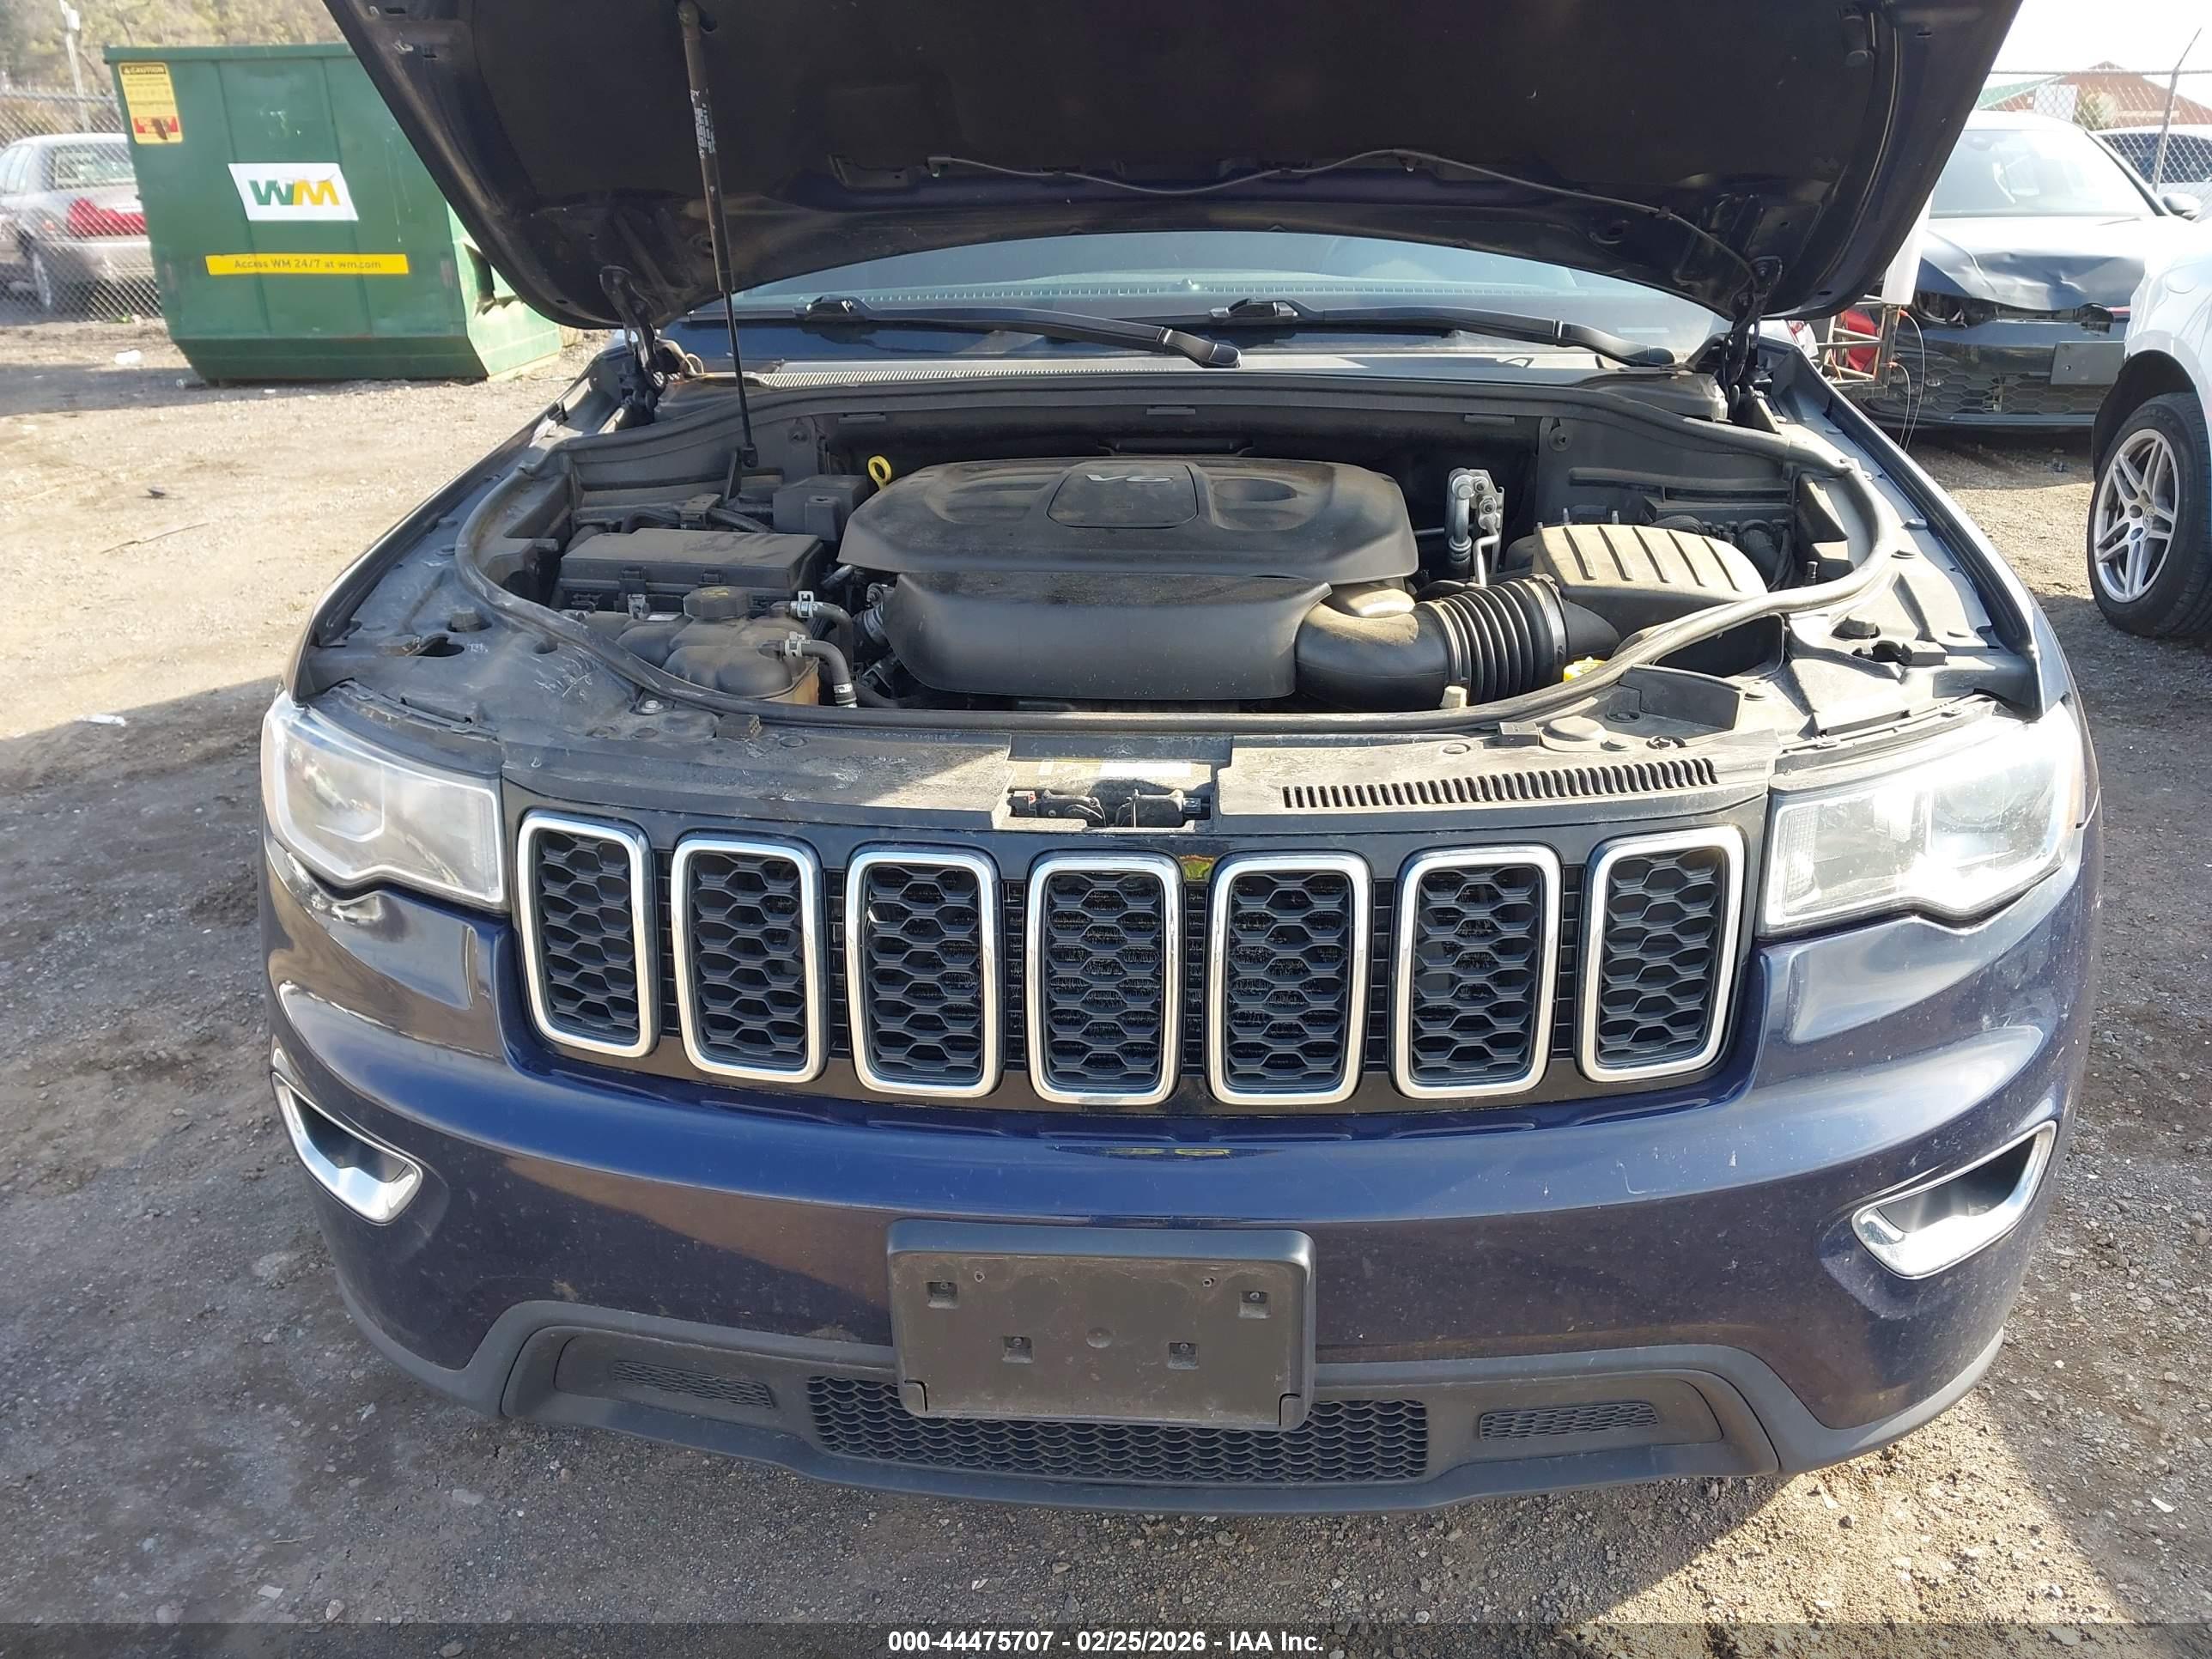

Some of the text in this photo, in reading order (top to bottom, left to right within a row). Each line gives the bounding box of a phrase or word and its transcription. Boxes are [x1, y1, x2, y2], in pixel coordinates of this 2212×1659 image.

[249, 179, 340, 206] WM
[234, 259, 269, 269] Access
[271, 258, 292, 269] WM
[295, 258, 320, 269] 24/7
[325, 260, 335, 269] at
